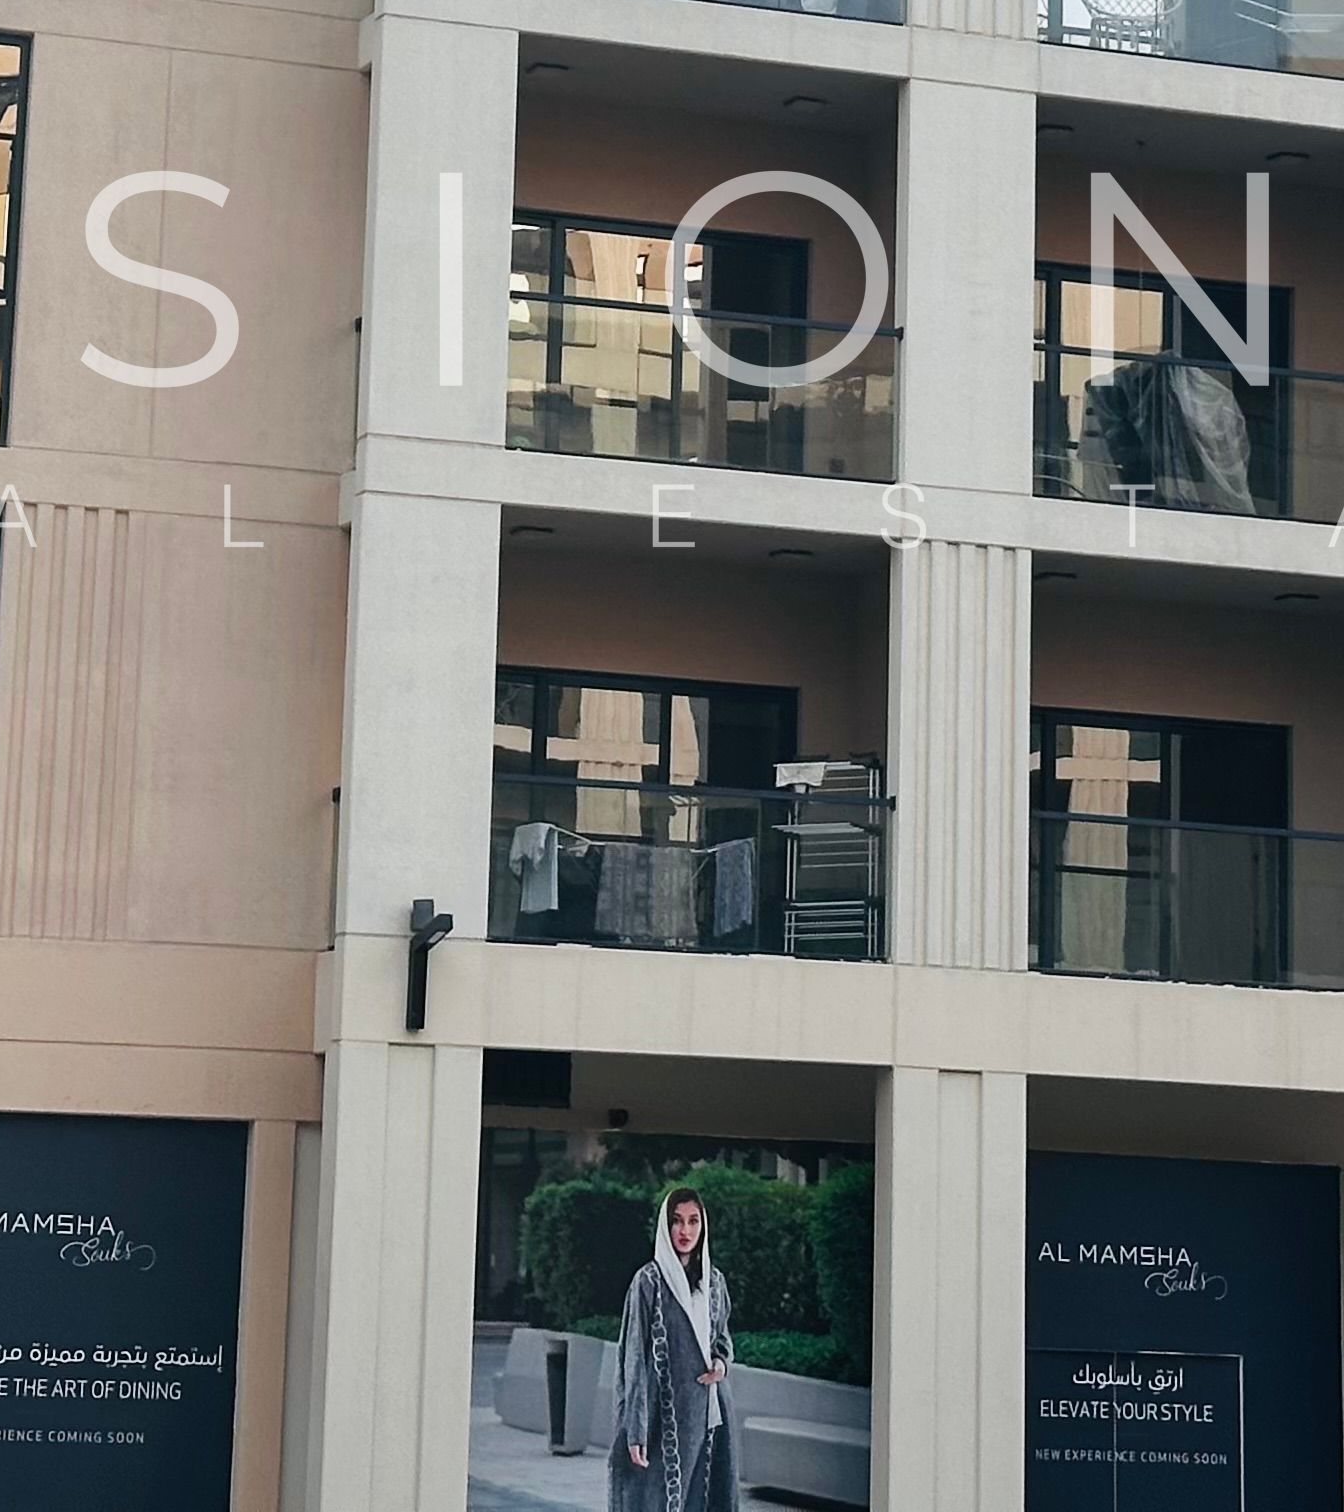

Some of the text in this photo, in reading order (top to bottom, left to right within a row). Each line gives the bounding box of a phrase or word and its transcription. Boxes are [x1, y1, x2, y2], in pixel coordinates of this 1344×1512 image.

[59, 1231, 155, 1270] Souks
[1038, 1242, 1192, 1266] AL MAMSHA
[1144, 1262, 1228, 1301] Souks
[29, 1342, 86, 1366] مميزة
[93, 1343, 148, 1369] بتجربة
[154, 1345, 223, 1372] إستمتع
[13, 1378, 48, 1398] THE
[52, 1379, 87, 1399] ART
[91, 1380, 116, 1399] OF
[119, 1381, 182, 1401] DINING
[1040, 1400, 1214, 1423] ELEVATE YOUR STYLE
[48, 1430, 103, 1444] COMING
[107, 1431, 145, 1445] SOON
[1035, 1448, 1228, 1466] NEW EXPERIENCE COMING SOON
